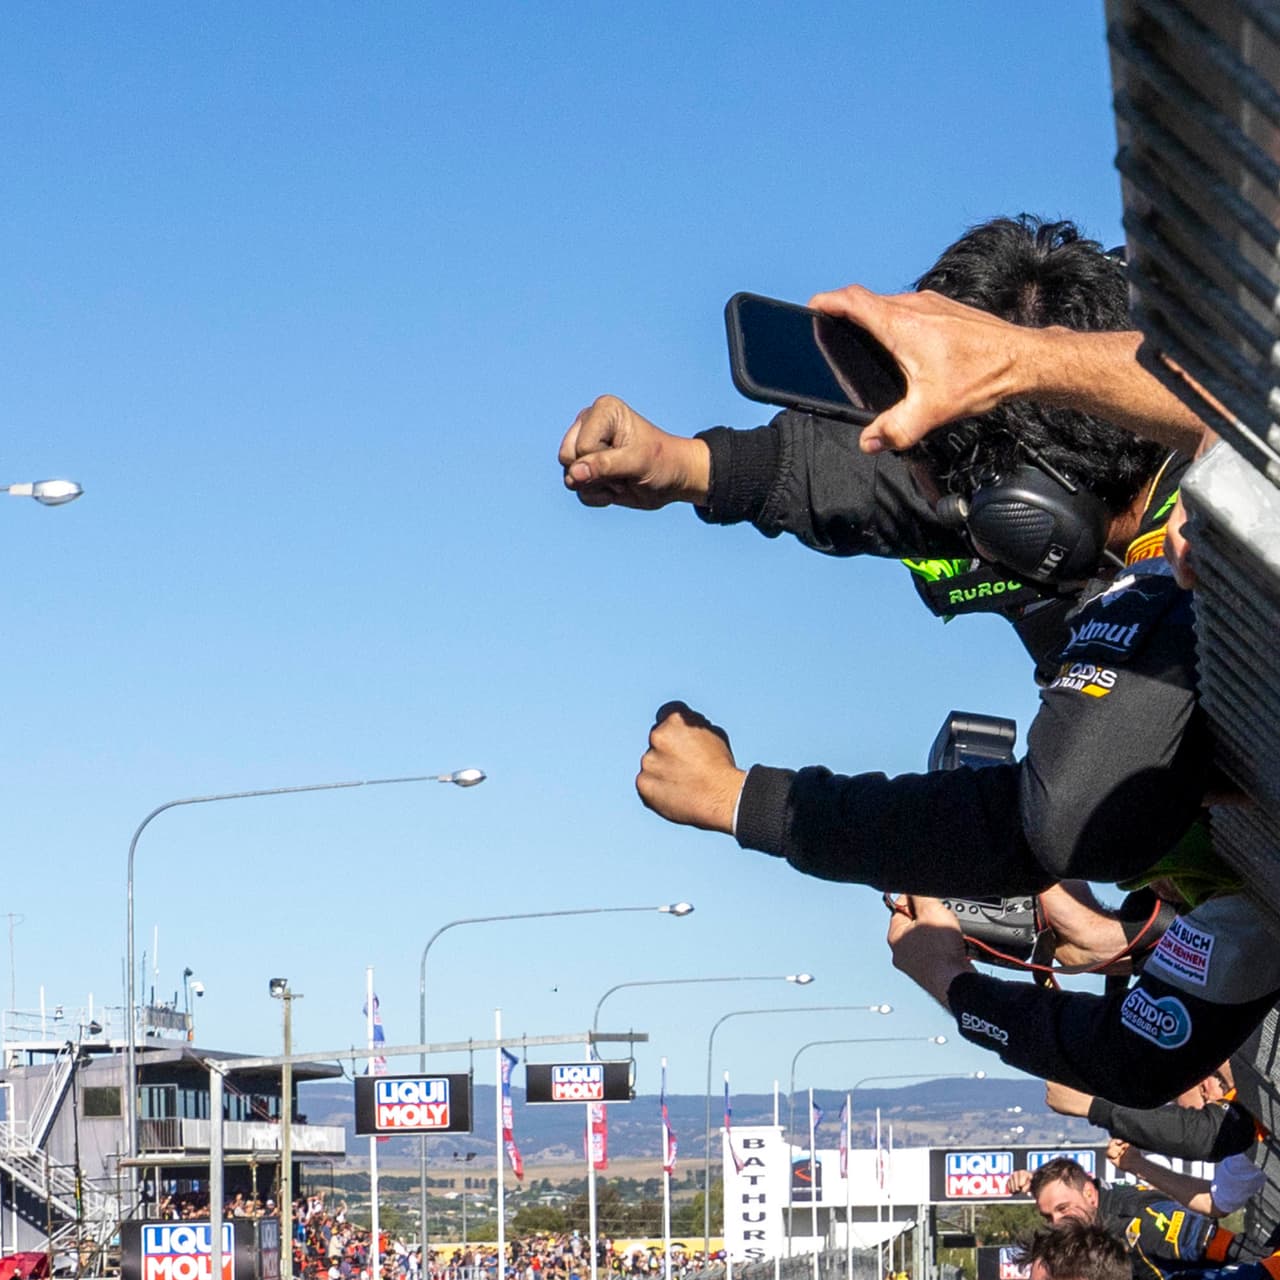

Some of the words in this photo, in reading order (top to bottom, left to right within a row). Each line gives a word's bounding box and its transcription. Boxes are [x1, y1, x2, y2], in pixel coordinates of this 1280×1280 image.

[1180, 927, 1211, 952] BUCH
[1172, 943, 1207, 968] RENNEN
[1127, 992, 1175, 1031] STUDIO
[556, 1066, 601, 1083] LIQUI
[379, 1081, 445, 1104] LIQUI
[556, 1083, 601, 1099] MOLY
[380, 1104, 448, 1126] MOLY
[949, 1154, 1010, 1175] LIQUI
[949, 1175, 1010, 1196] MOLY
[742, 1138, 766, 1259] BATHURS
[147, 1227, 229, 1254] LIQUI
